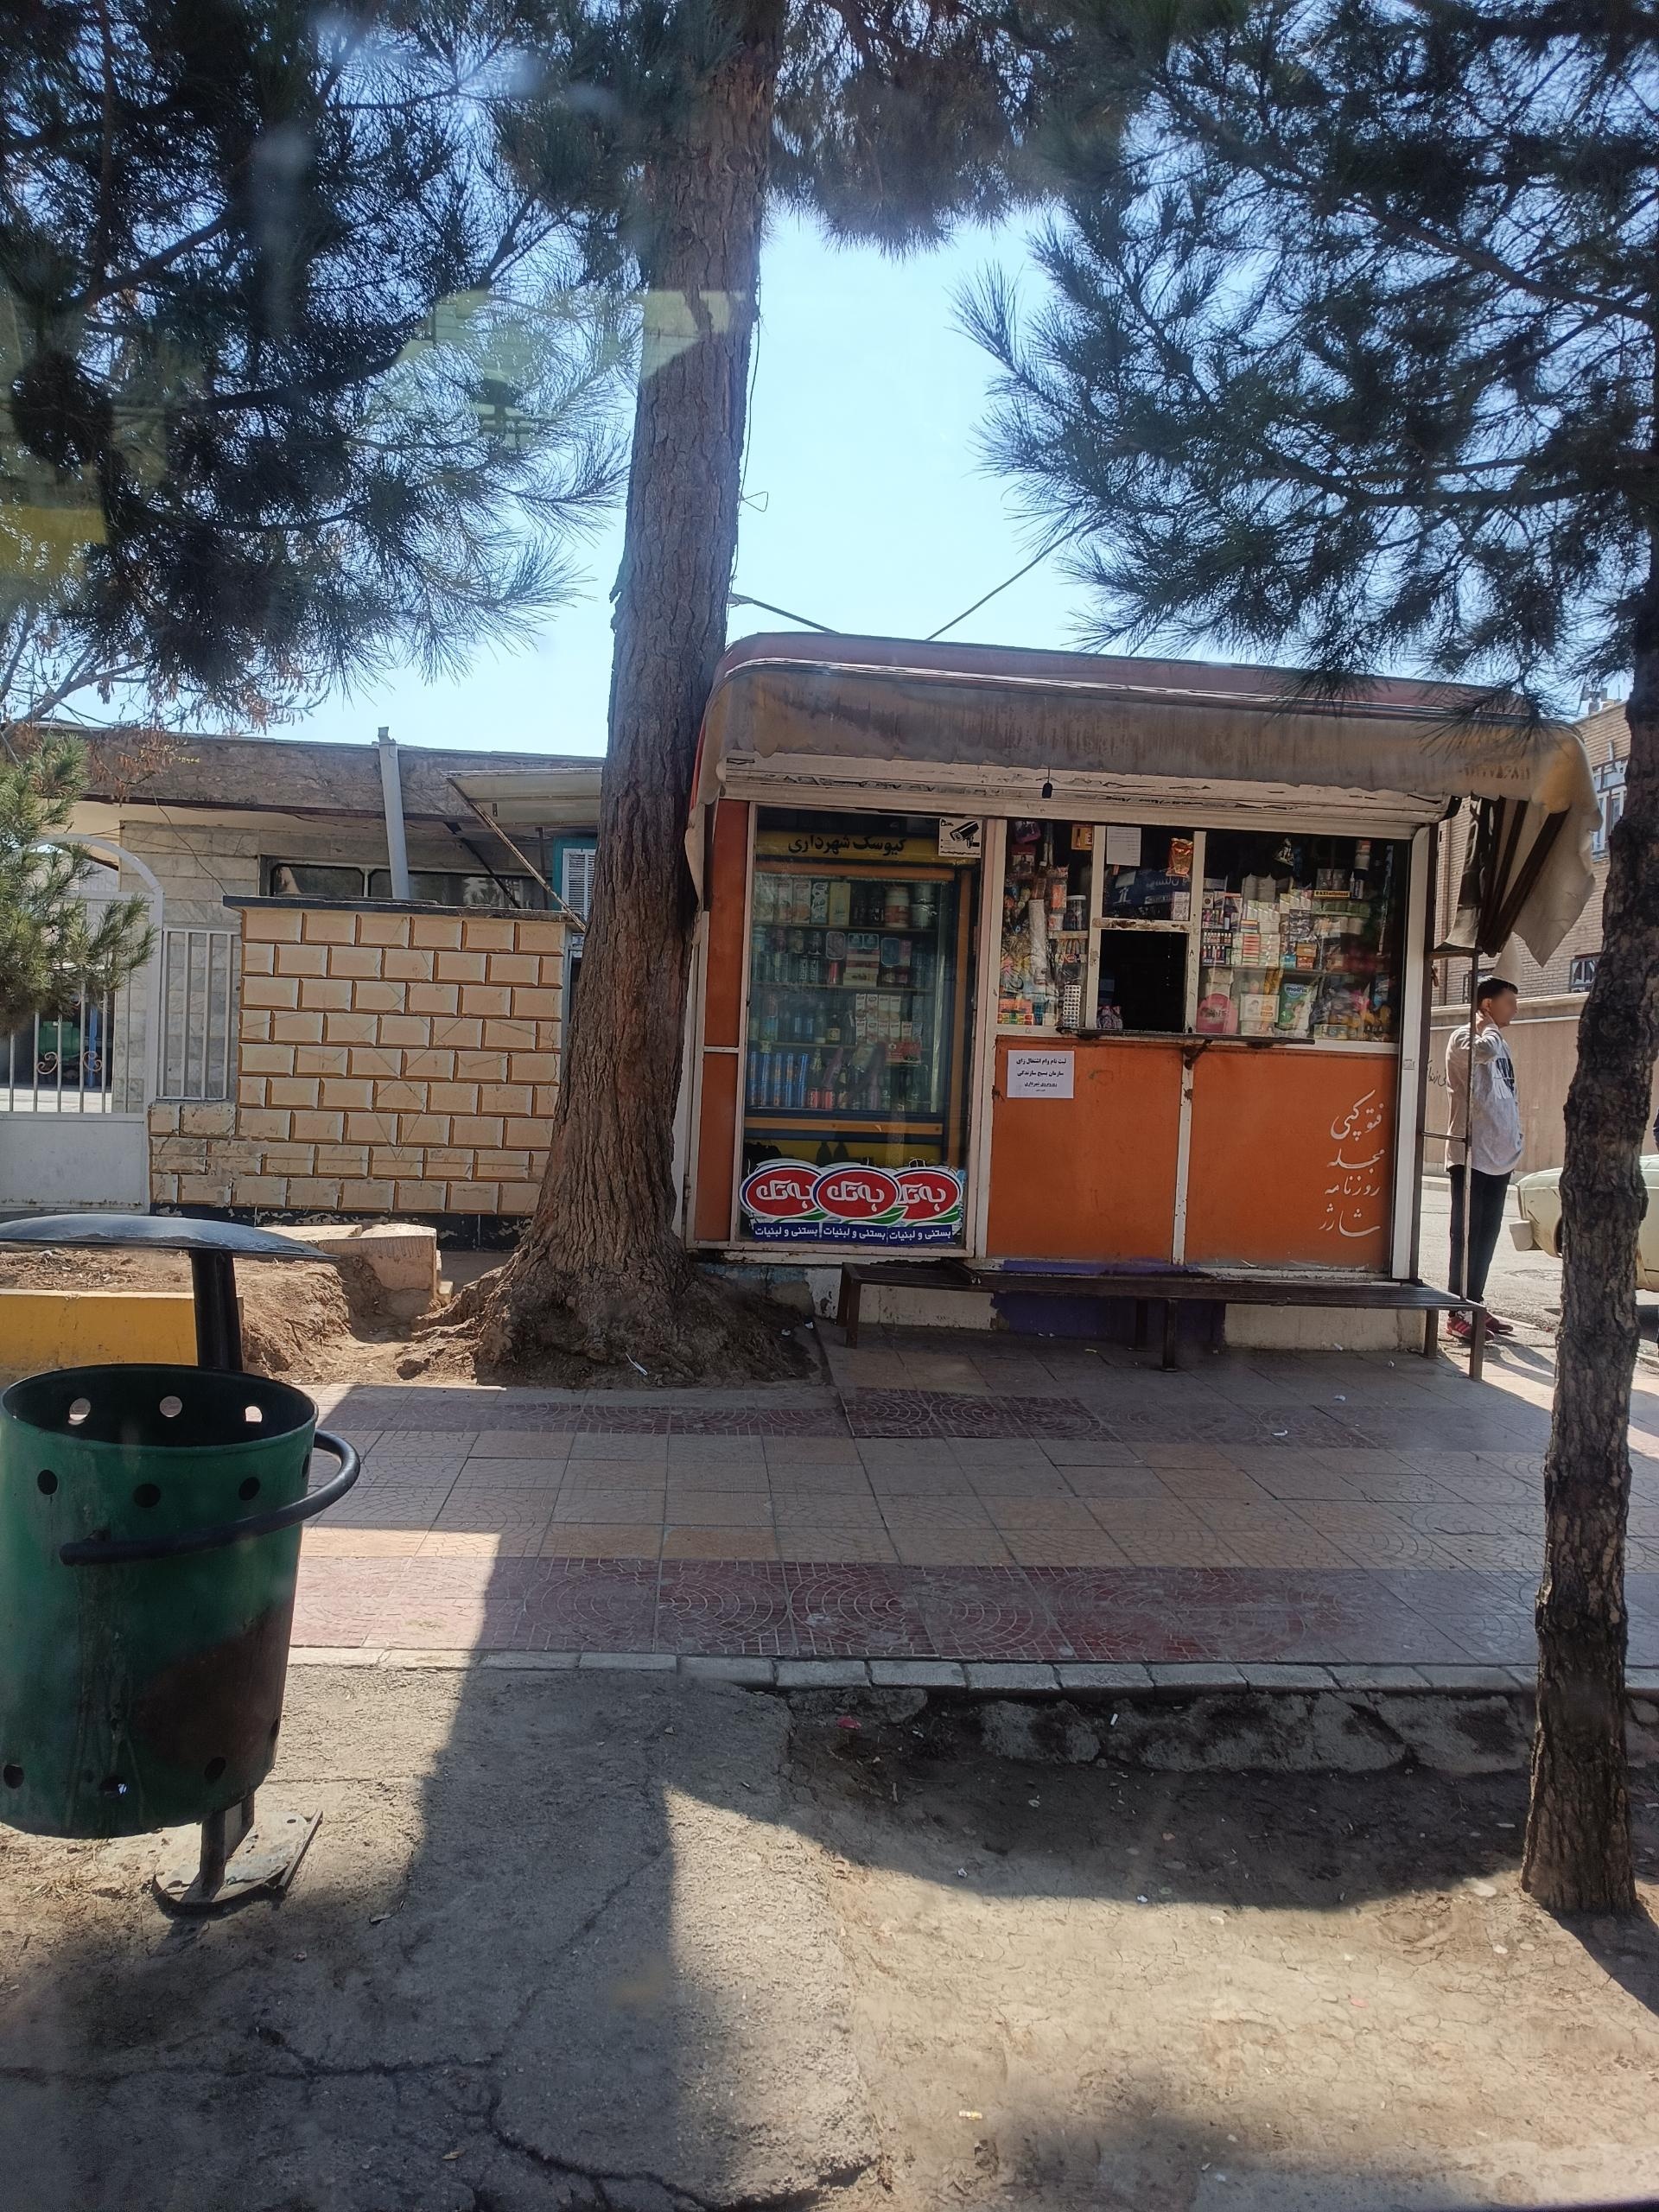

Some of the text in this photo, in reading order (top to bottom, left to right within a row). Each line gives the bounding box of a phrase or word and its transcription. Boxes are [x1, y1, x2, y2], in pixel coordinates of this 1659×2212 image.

[788, 835, 907, 856] کیوسک شهرداری
[1327, 1148, 1385, 1173] مجله
[1325, 1175, 1381, 1197] روزنامه
[1319, 1203, 1382, 1237] شارژ
[754, 1226, 818, 1237] بستنی و لبنیات
[823, 1227, 886, 1240] بستنی و لبنیات
[889, 1229, 951, 1242] بستنی و لبنیات
